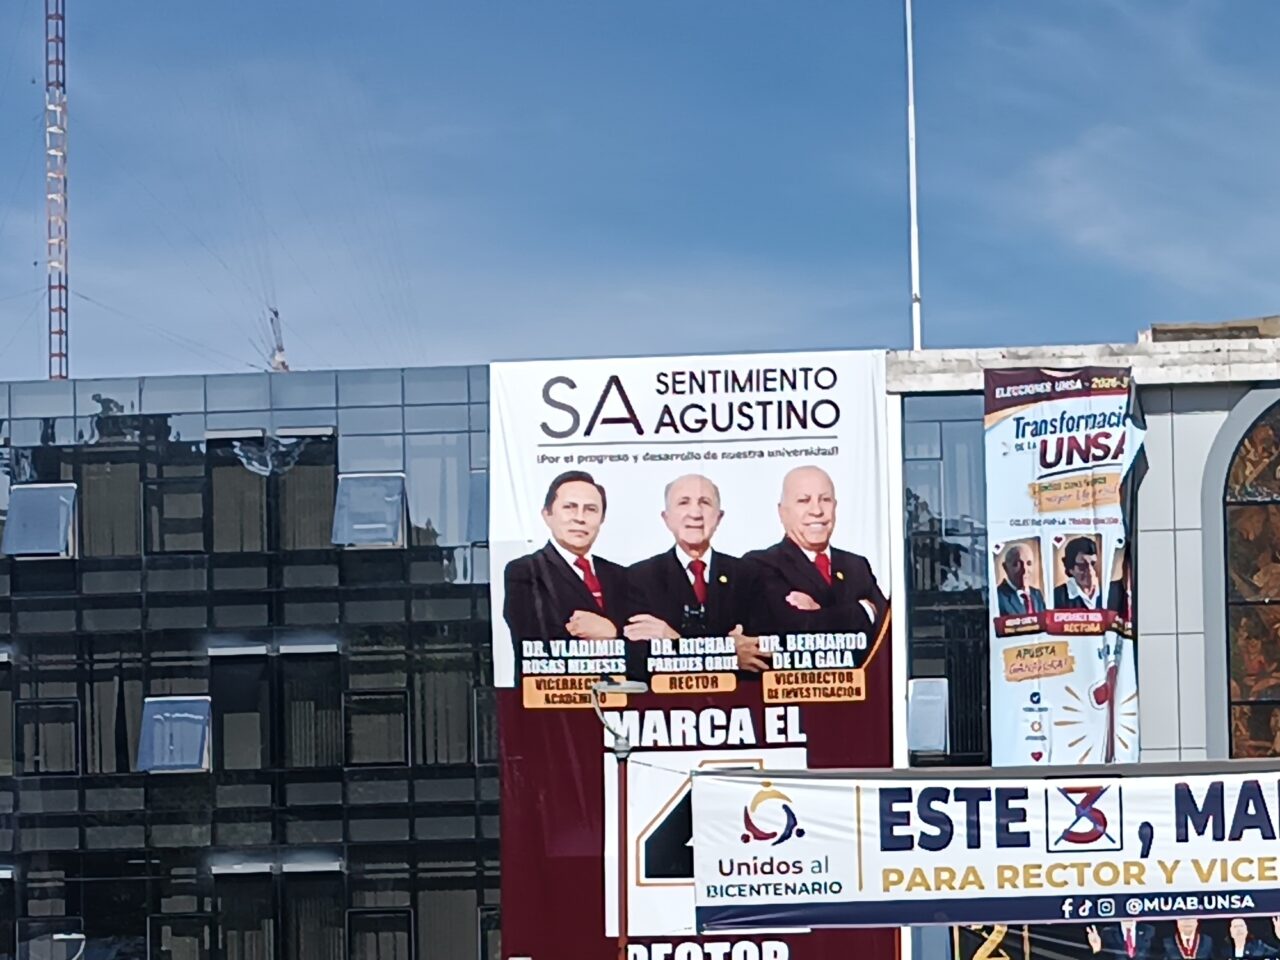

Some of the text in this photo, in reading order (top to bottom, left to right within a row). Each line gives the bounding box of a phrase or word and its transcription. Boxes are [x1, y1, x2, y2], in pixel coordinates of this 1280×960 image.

[655, 367, 837, 396] SENTIMIENTO
[540, 375, 644, 438] SA
[654, 399, 840, 434] AGUSTINO
[550, 639, 626, 657] VLADIMIR
[773, 650, 854, 669] DE LA GALA
[669, 675, 718, 690] RECTOR
[604, 707, 806, 748] MARCA EL
[878, 787, 1030, 852] ESTE
[718, 854, 829, 878] Unidos al
[881, 865, 985, 893] PARA
[996, 861, 1145, 889] RECTOR
[1157, 859, 1181, 884] Y
[706, 881, 842, 899] BICENTENARIO
[1125, 894, 1254, 916] @MUAB.UNSA
